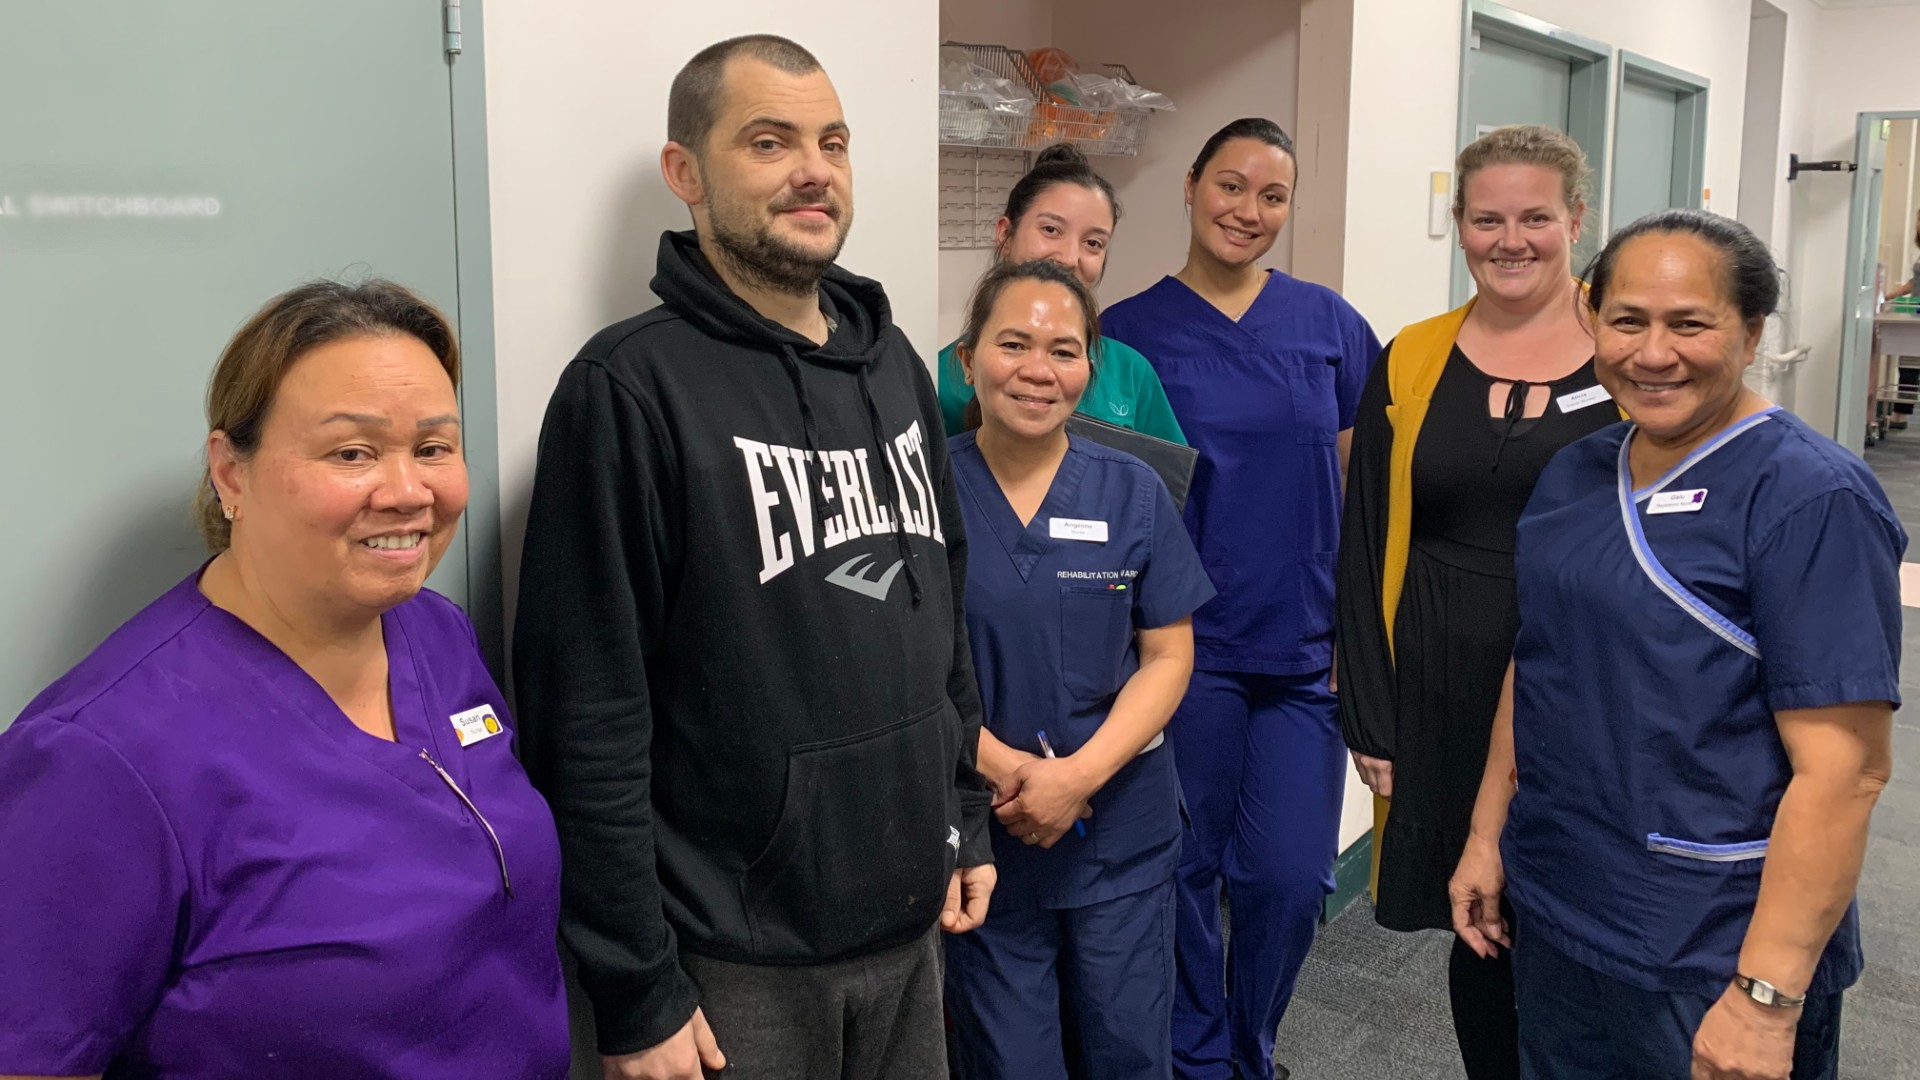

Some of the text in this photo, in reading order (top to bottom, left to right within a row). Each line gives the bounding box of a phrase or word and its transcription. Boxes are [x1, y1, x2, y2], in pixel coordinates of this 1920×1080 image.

[30, 195, 220, 216] SWITCHBOARD
[733, 420, 946, 585] EVERLAST
[1057, 570, 1118, 579] REHABILITATION
[459, 714, 481, 726] Susan
